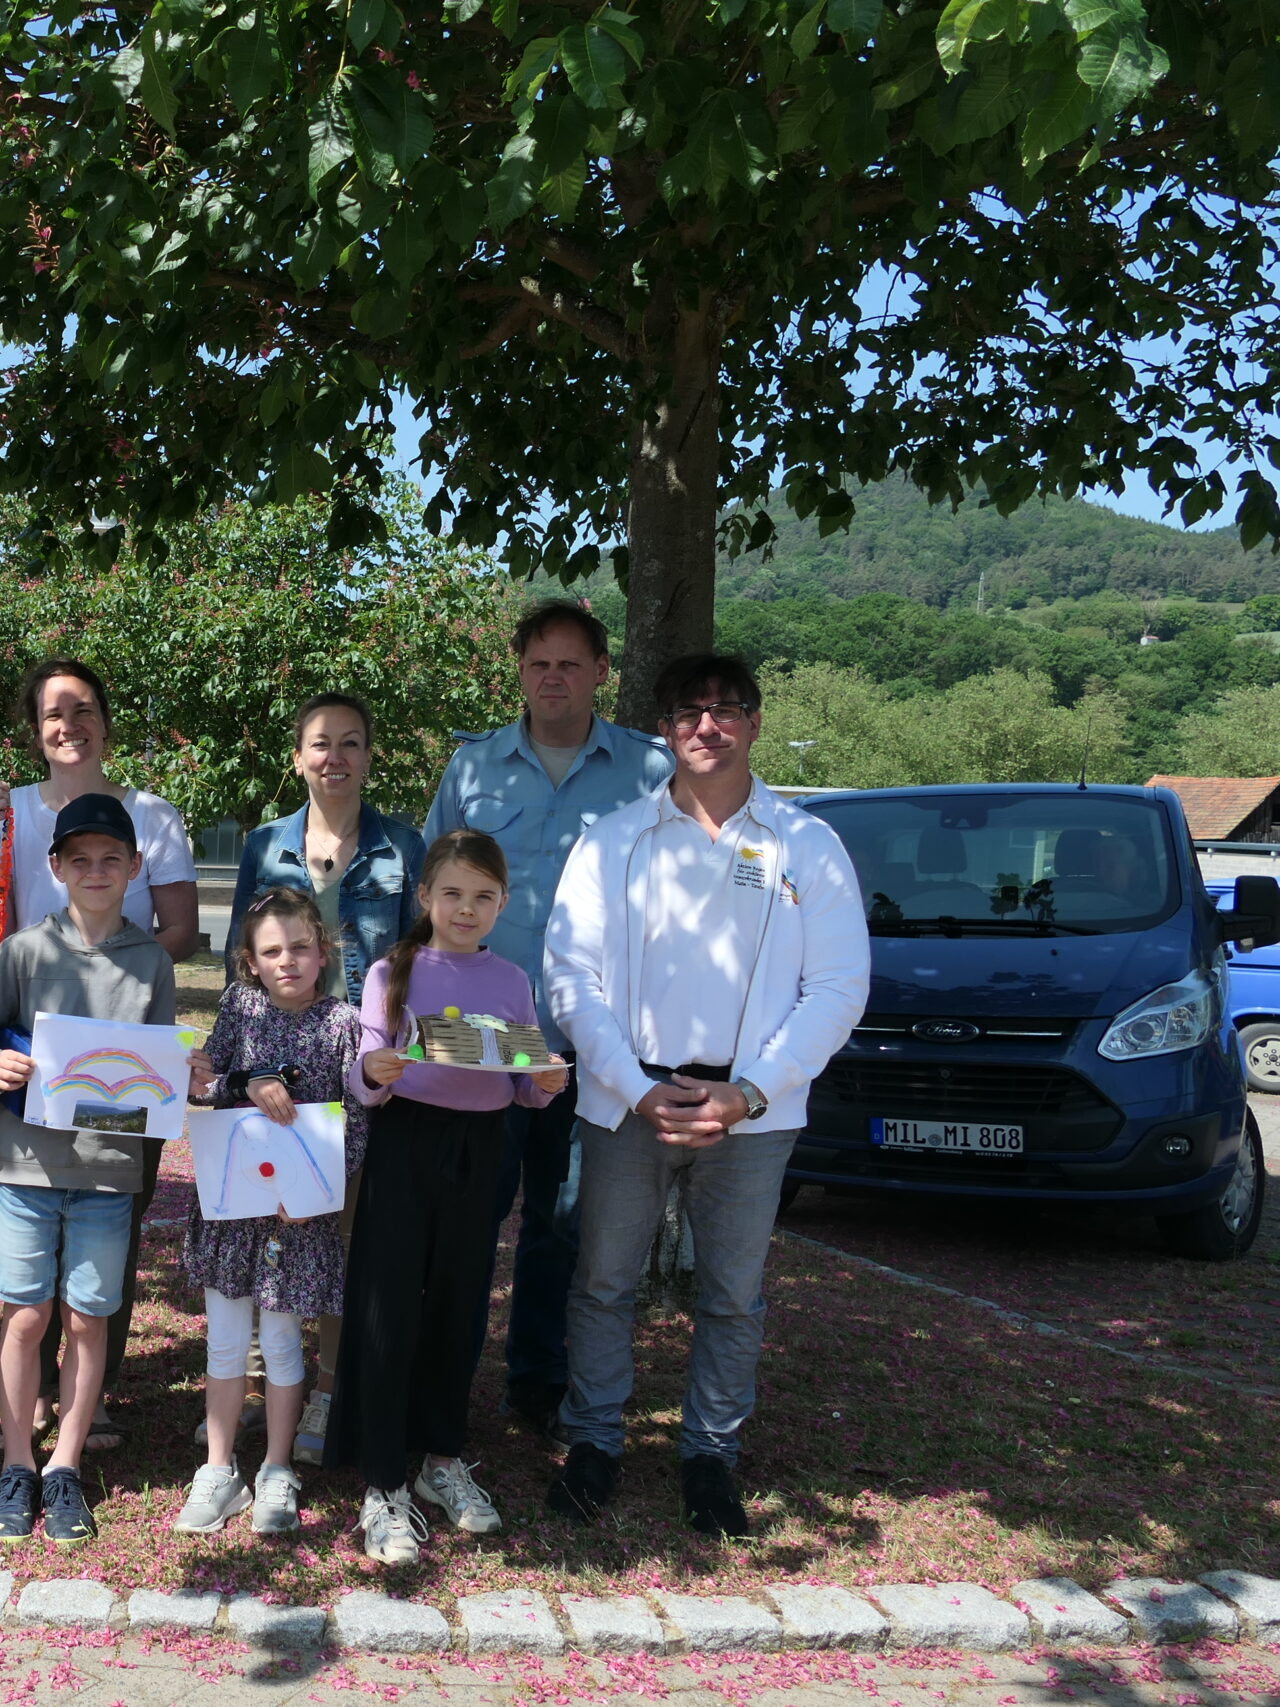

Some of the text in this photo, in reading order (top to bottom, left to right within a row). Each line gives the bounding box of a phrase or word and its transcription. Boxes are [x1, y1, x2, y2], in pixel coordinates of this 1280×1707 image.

[926, 1022, 962, 1037] Ford
[884, 1121, 1021, 1150] MIL MI 808
